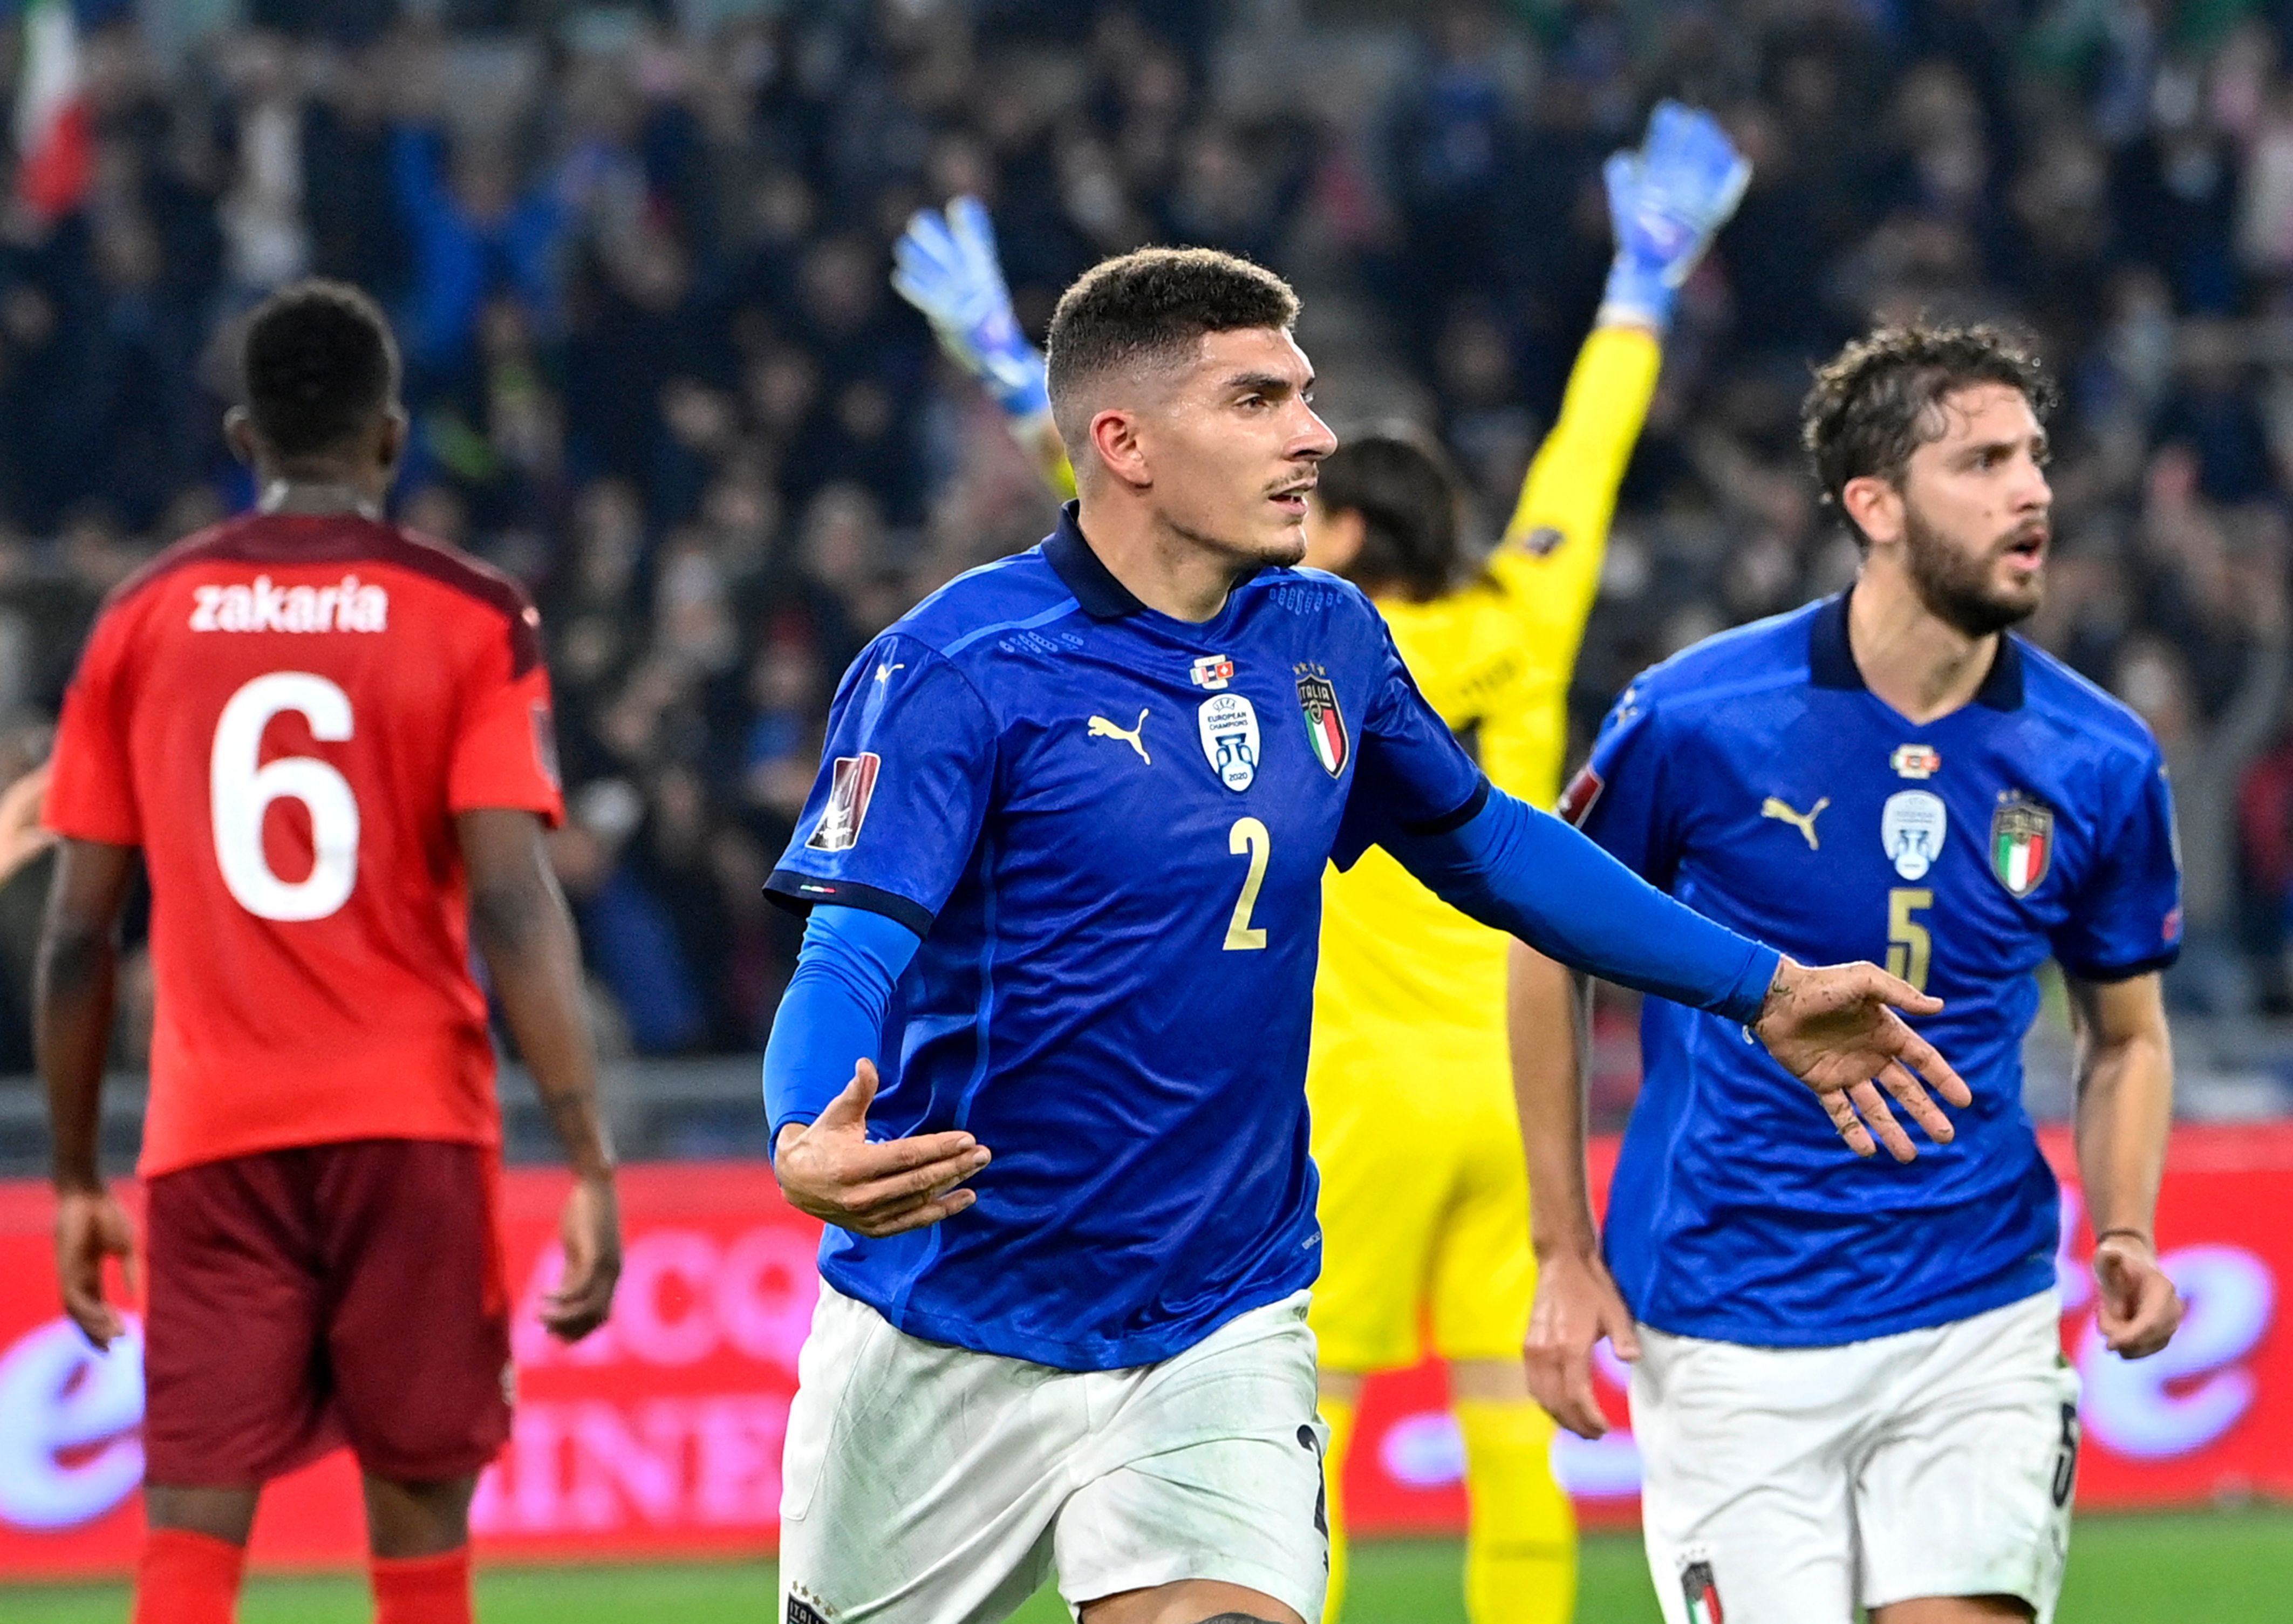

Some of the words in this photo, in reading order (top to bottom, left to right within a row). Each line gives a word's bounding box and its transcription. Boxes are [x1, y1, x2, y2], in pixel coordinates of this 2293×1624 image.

[190, 574, 387, 633] zakaria
[1212, 697, 1237, 712] UEFA
[1299, 684, 1330, 701] ITALIA
[1207, 712, 1246, 723] EUROPEAN
[1209, 719, 1248, 731] CHAMPIONS
[1229, 772, 1248, 782] 2020
[210, 671, 360, 922] 6
[1222, 817, 1270, 951] 2
[1886, 888, 1933, 993] 5
[2053, 1402, 2076, 1507] 5
